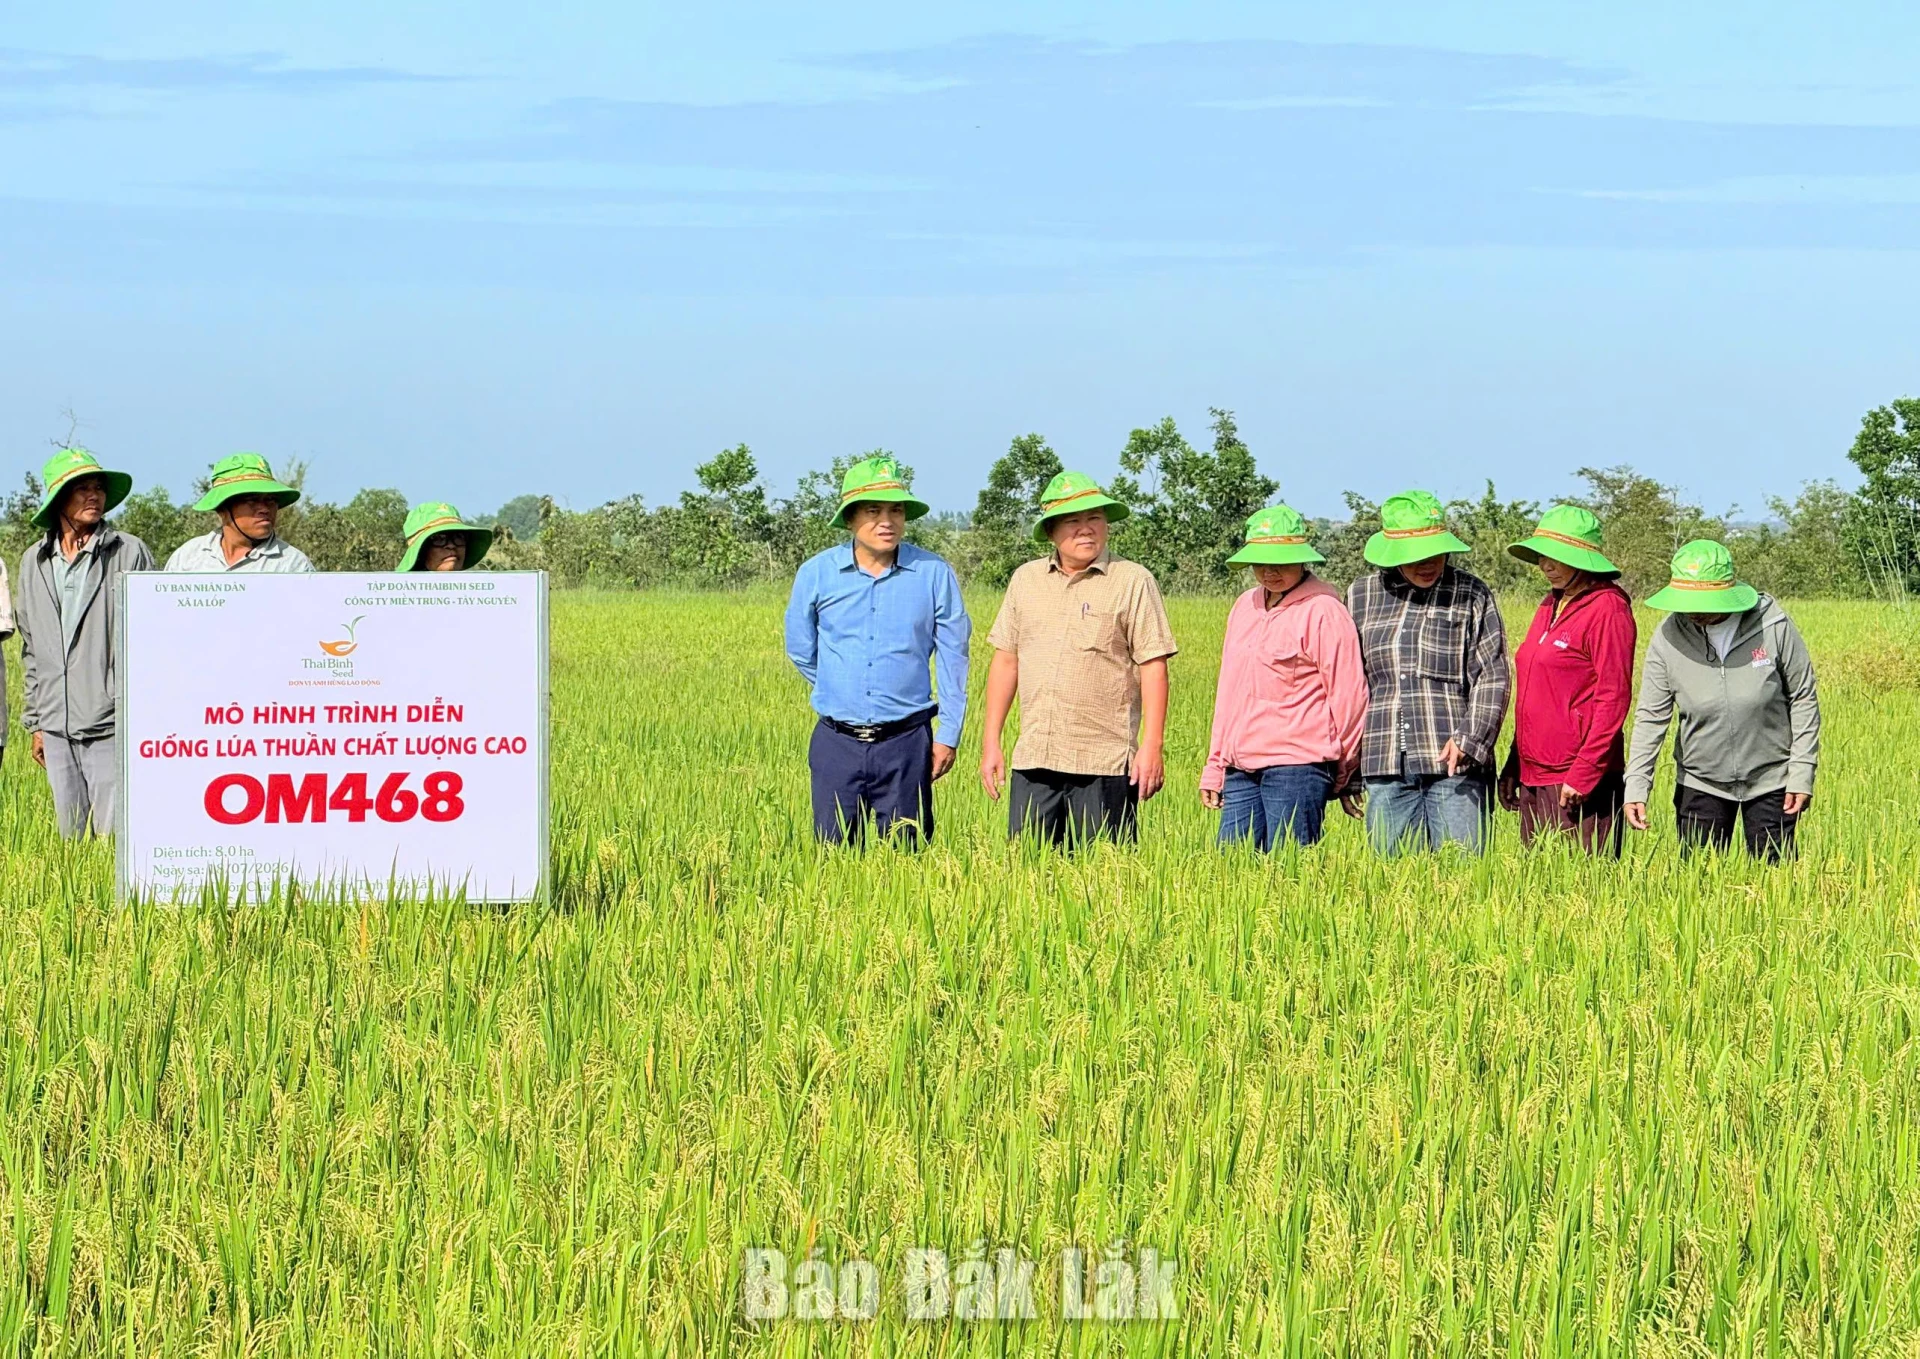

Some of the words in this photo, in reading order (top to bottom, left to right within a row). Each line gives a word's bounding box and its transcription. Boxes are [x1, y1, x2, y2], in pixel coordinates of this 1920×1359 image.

[171, 584, 192, 592] BAN
[193, 582, 222, 592] NHÂN
[224, 582, 246, 592] DÂN
[418, 582, 467, 591] THAIBINH
[468, 582, 495, 591] SEED
[344, 596, 374, 606] CÔNG
[375, 598, 388, 606] TY
[390, 593, 415, 606] MIỀN
[416, 597, 450, 606] TRUNG
[457, 595, 475, 605] TÂY
[477, 595, 517, 605] NGUYÊN
[332, 669, 354, 678] Seed
[204, 702, 245, 725] MÔ
[253, 701, 315, 724] HÌNH
[324, 700, 398, 723] TRÌNH
[406, 697, 463, 723] DIỄN
[139, 734, 209, 758] GIỐNG
[216, 735, 257, 757] LÚA
[264, 732, 336, 757] THUẦN
[343, 731, 399, 756] CHẤT
[405, 736, 477, 760] LƯỢNG
[484, 736, 527, 755] CAO
[204, 771, 465, 825] OM468
[153, 847, 183, 860] Diện
[186, 846, 212, 858] tích:
[239, 845, 255, 857] ha
[153, 864, 185, 877] Ngày
